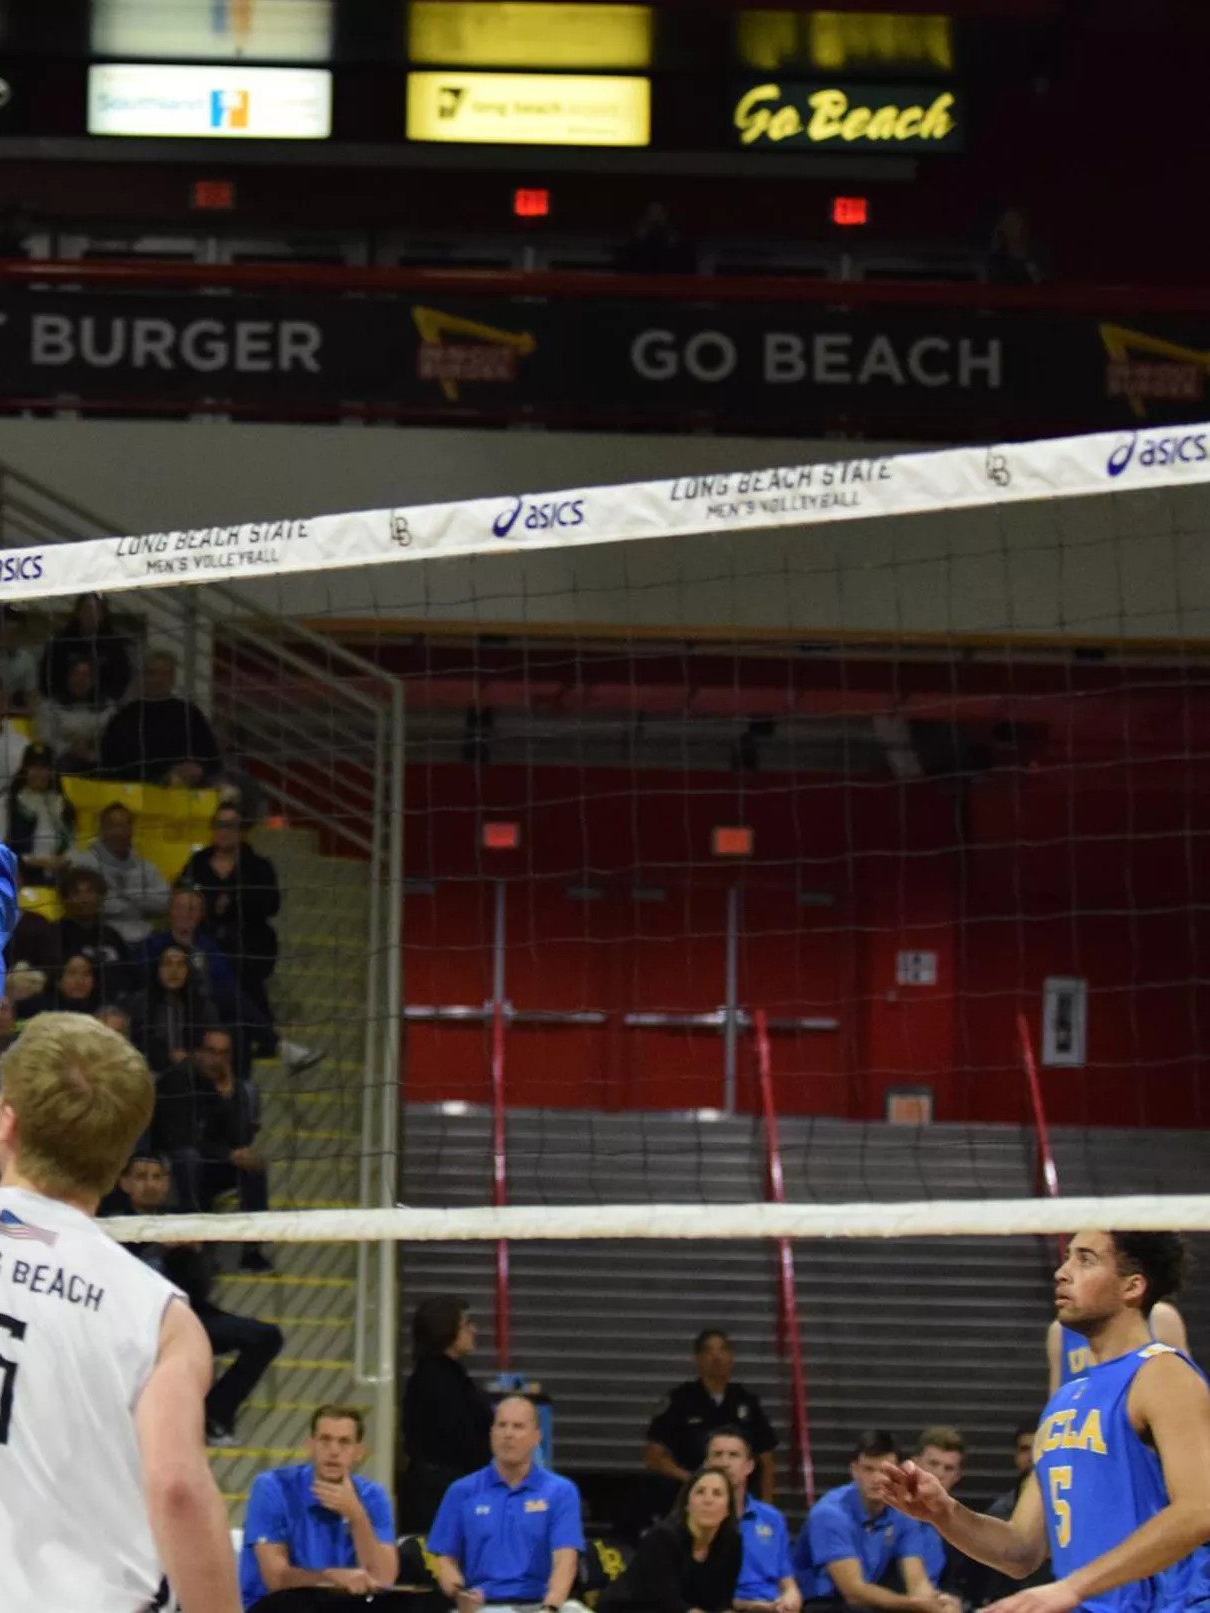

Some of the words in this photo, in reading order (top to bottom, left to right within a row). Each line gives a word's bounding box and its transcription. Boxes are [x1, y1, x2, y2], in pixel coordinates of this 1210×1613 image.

[734, 84, 803, 144] Go
[807, 88, 956, 142] Beach
[31, 314, 323, 373] BURGER
[631, 329, 738, 383] GO
[764, 333, 1002, 388] BEACH
[671, 476, 728, 501] LONG
[737, 469, 811, 493] BEACH
[822, 460, 891, 486] STATE
[116, 534, 167, 556] LONG
[175, 528, 238, 550] BEACH
[249, 522, 308, 543] STATE
[12, 1260, 105, 1312] BEACH
[1049, 1465, 1072, 1549] 5
